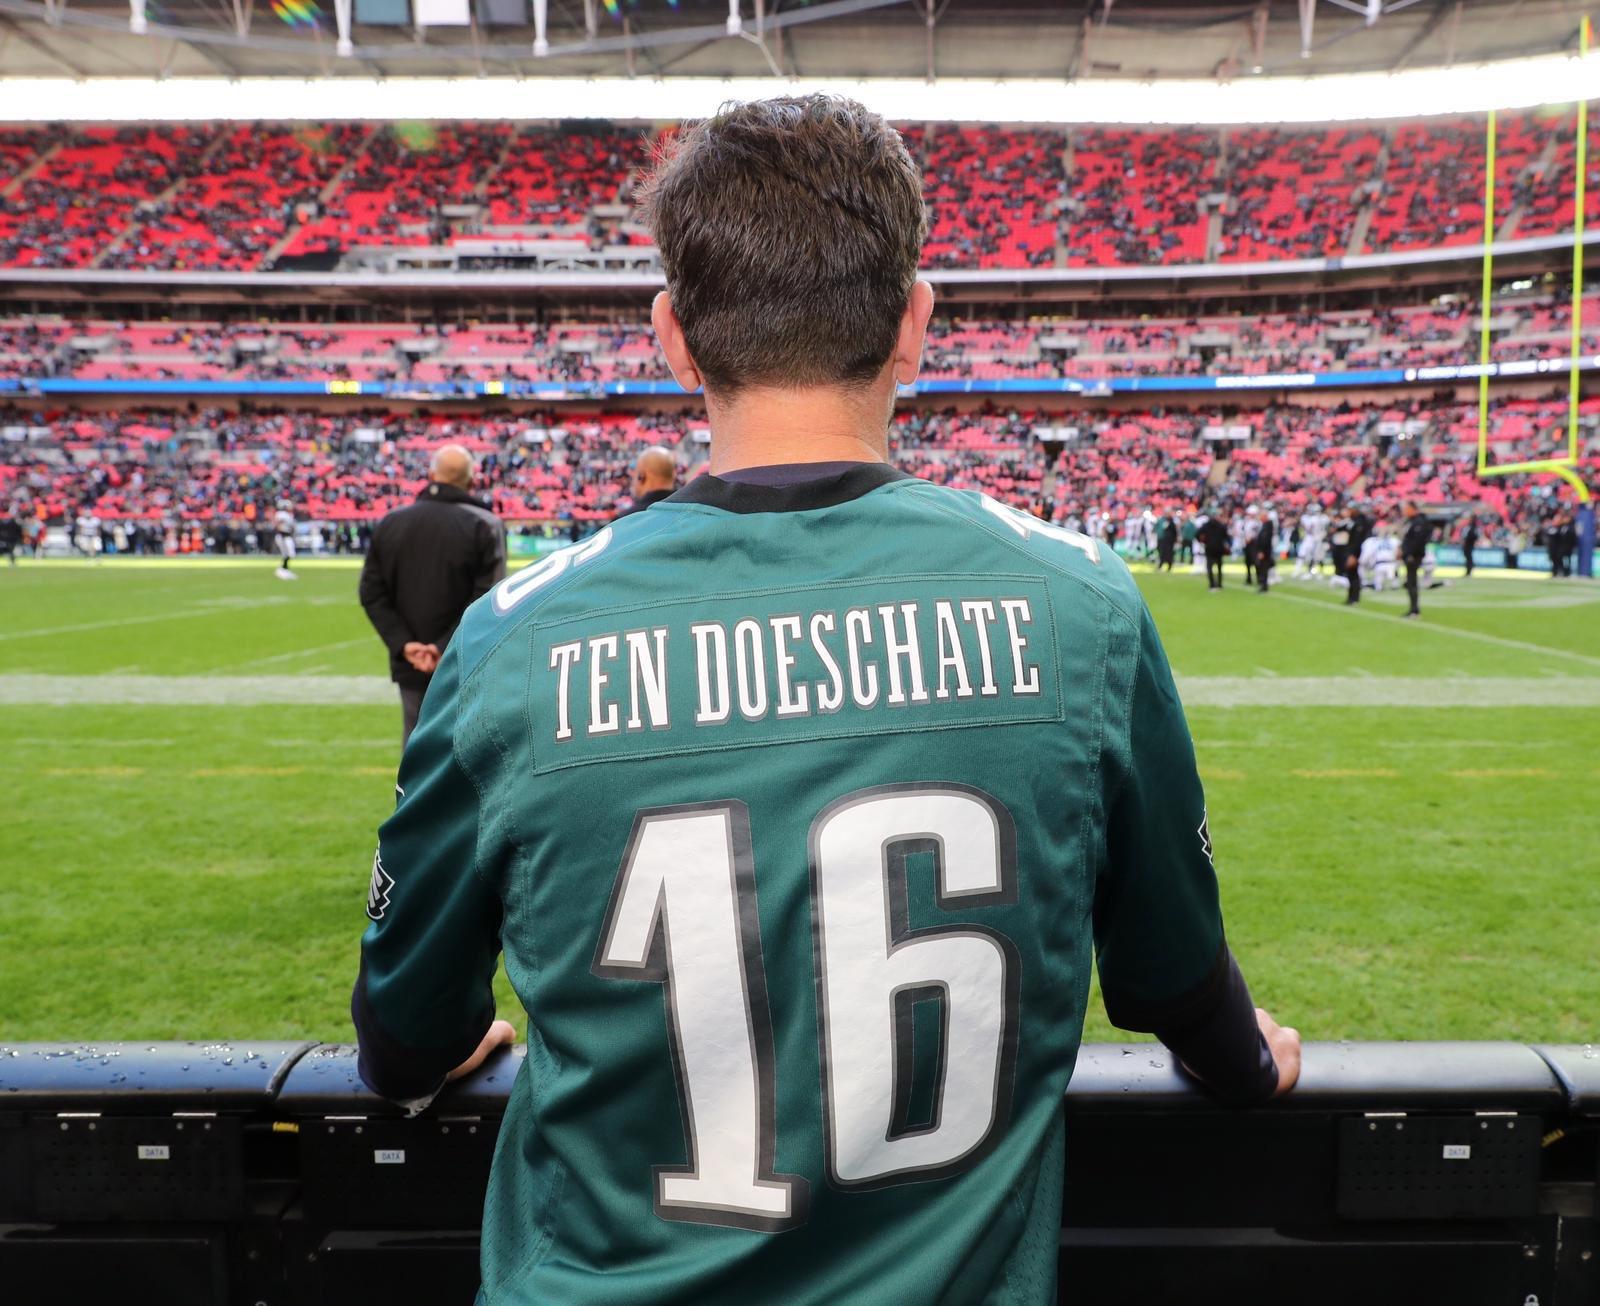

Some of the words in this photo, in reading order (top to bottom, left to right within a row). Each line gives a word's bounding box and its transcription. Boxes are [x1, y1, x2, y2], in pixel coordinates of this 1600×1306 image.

[549, 625, 670, 743] TEN
[690, 598, 1042, 723] DOESCHATE
[590, 781, 1022, 1233] 16
[382, 1151, 401, 1161] DATA
